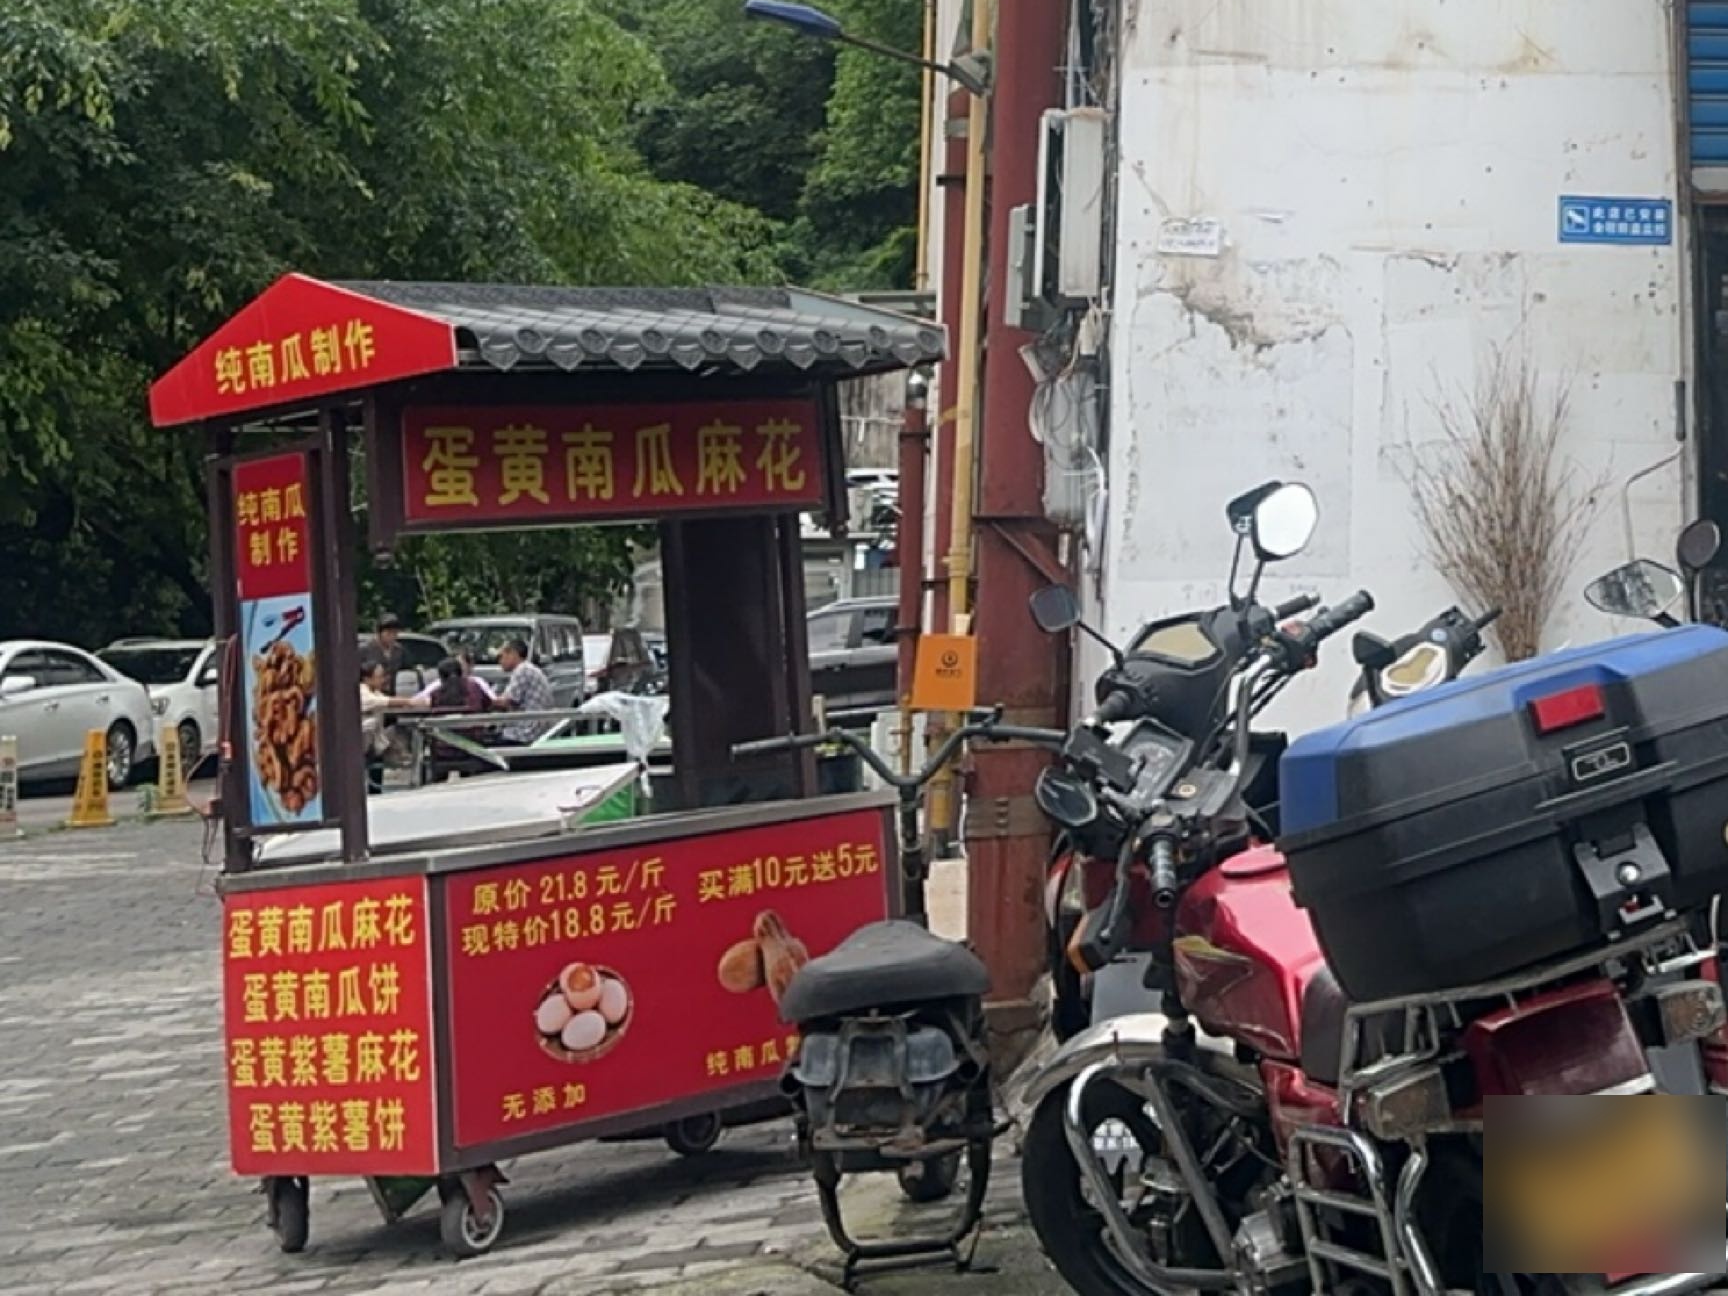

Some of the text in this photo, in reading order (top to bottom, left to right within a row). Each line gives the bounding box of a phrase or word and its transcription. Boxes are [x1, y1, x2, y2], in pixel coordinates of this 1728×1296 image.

[215, 318, 375, 394] 纯南瓜制作
[422, 417, 807, 508] 蛋黄南瓜麻花
[237, 482, 305, 526] 纯南瓜
[250, 526, 298, 566] 制作
[699, 843, 879, 903] 买满10元送5元
[229, 893, 415, 958] 蛋黄南瓜麻花
[243, 962, 399, 1022] 蛋黄南瓜饼
[231, 1028, 420, 1087] 蛋黄紫薯麻花
[250, 1097, 405, 1152] 蛋黄紫薯饼
[502, 1083, 587, 1122] 无添加
